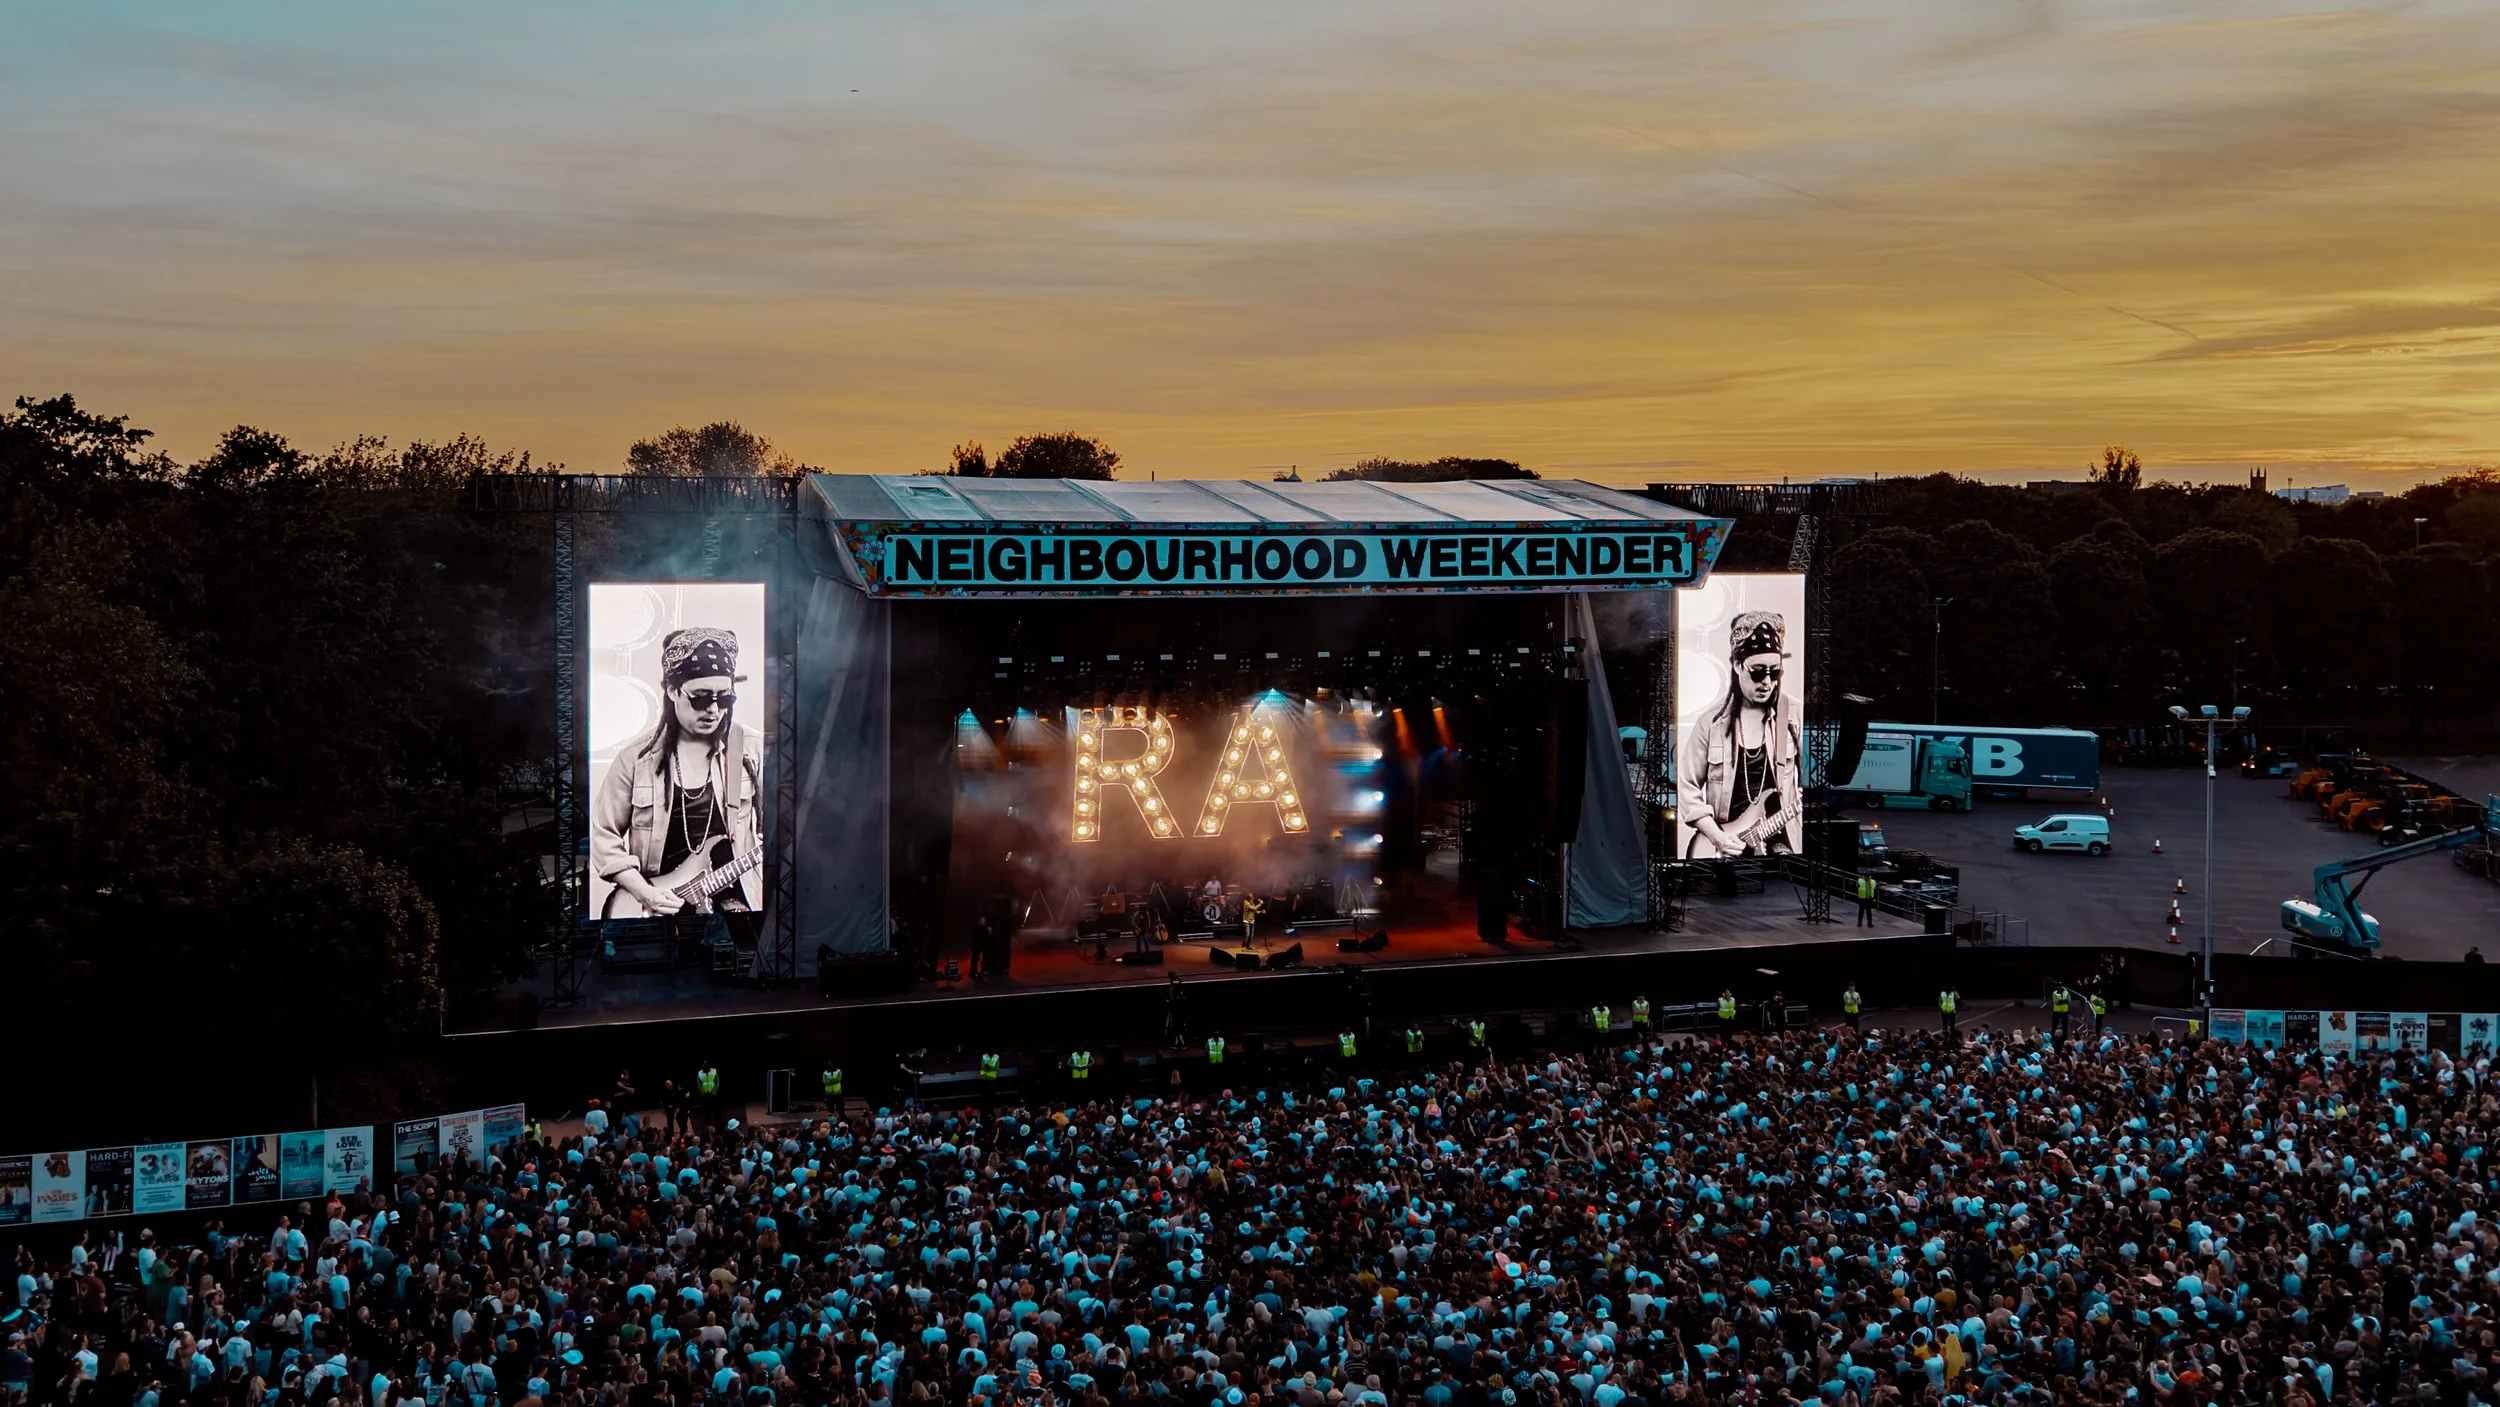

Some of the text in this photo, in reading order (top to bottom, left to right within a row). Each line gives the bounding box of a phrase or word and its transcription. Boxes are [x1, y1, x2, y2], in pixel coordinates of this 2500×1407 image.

[895, 535, 1685, 582] NEIGHBOURHOOD WEEKENDER
[1072, 706, 1310, 842] RA
[397, 1121, 438, 1134] THE SCRIPT
[136, 1143, 184, 1152] EMBRACE
[336, 1140, 363, 1149] LOWE
[140, 1152, 180, 1175] 30
[140, 1174, 180, 1185] YEARS
[1857, 1375, 1866, 1391] 9
